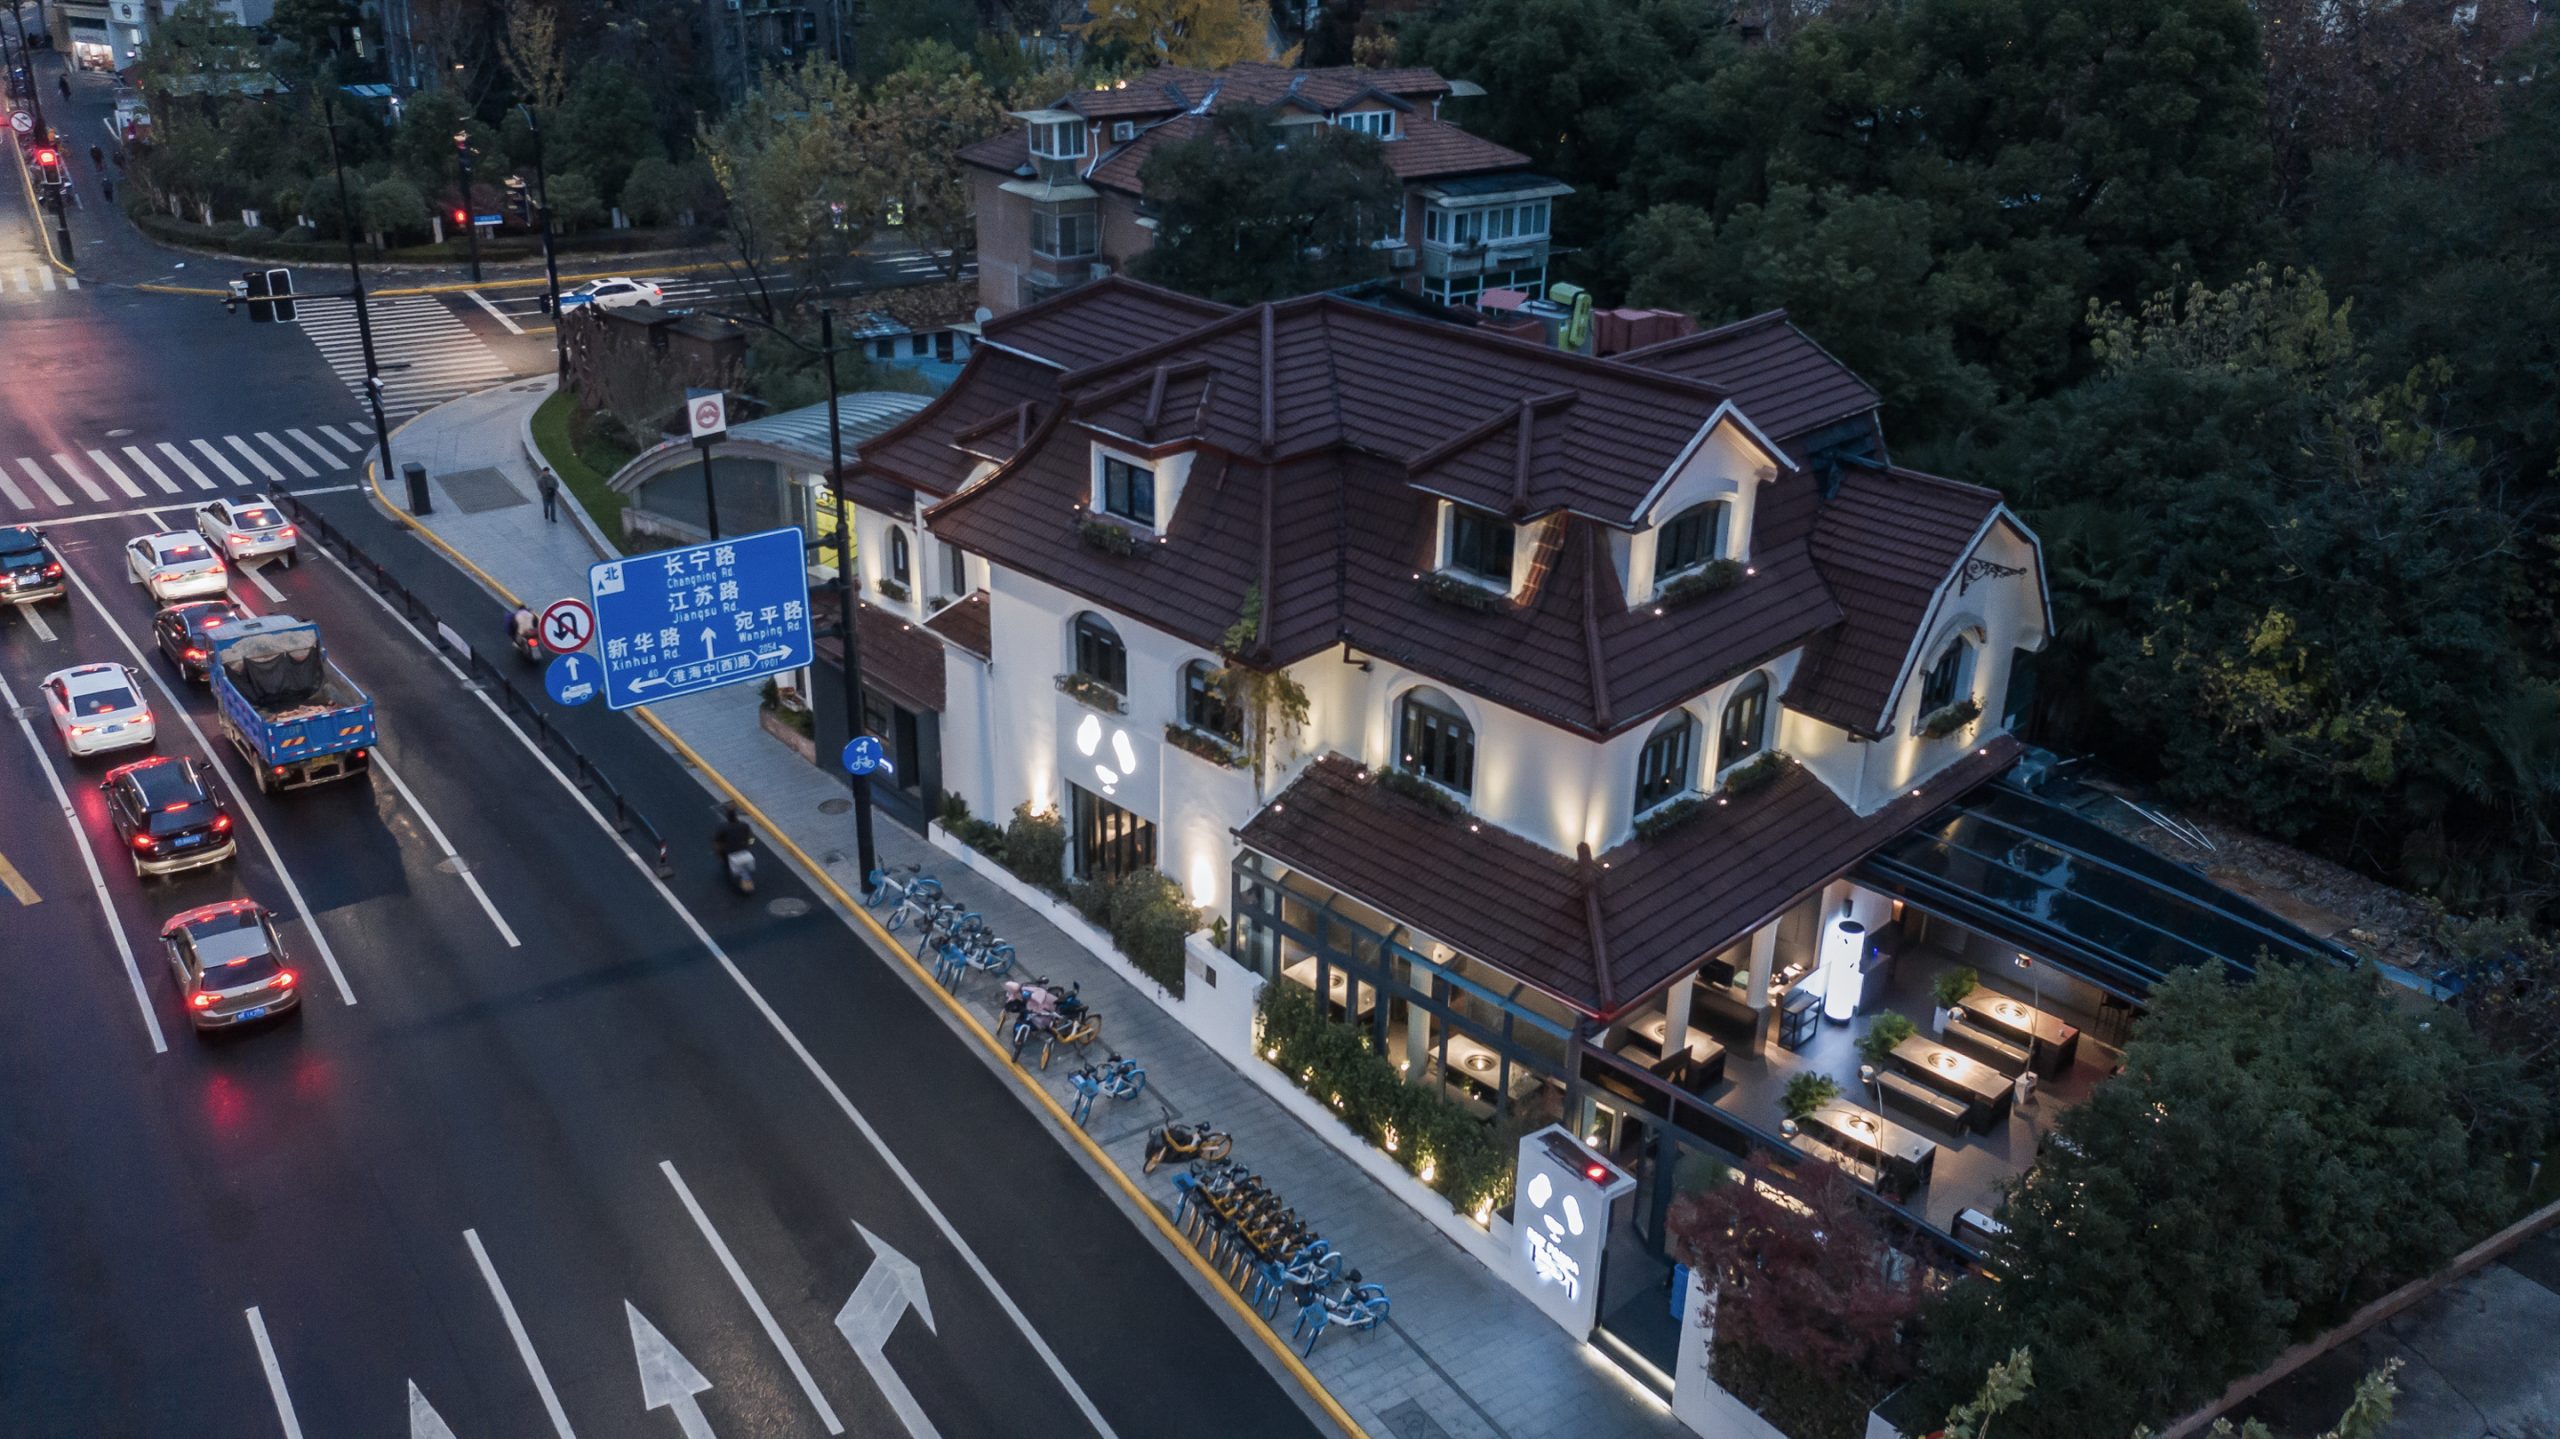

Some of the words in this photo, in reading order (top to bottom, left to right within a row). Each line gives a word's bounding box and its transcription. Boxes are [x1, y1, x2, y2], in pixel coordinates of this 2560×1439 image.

[664, 545, 736, 576] 长宁路
[604, 566, 619, 581] 北
[667, 571, 717, 589] Changning
[668, 580, 739, 612] 江苏路
[673, 607, 717, 623] Jiangsu
[722, 601, 739, 613] Rd.
[734, 600, 803, 631] 宛平路
[607, 627, 680, 659] 新华路
[739, 626, 782, 642] Wanping
[787, 621, 803, 632] Rd.
[612, 655, 657, 672] Xinhua
[663, 648, 680, 659] Rd.
